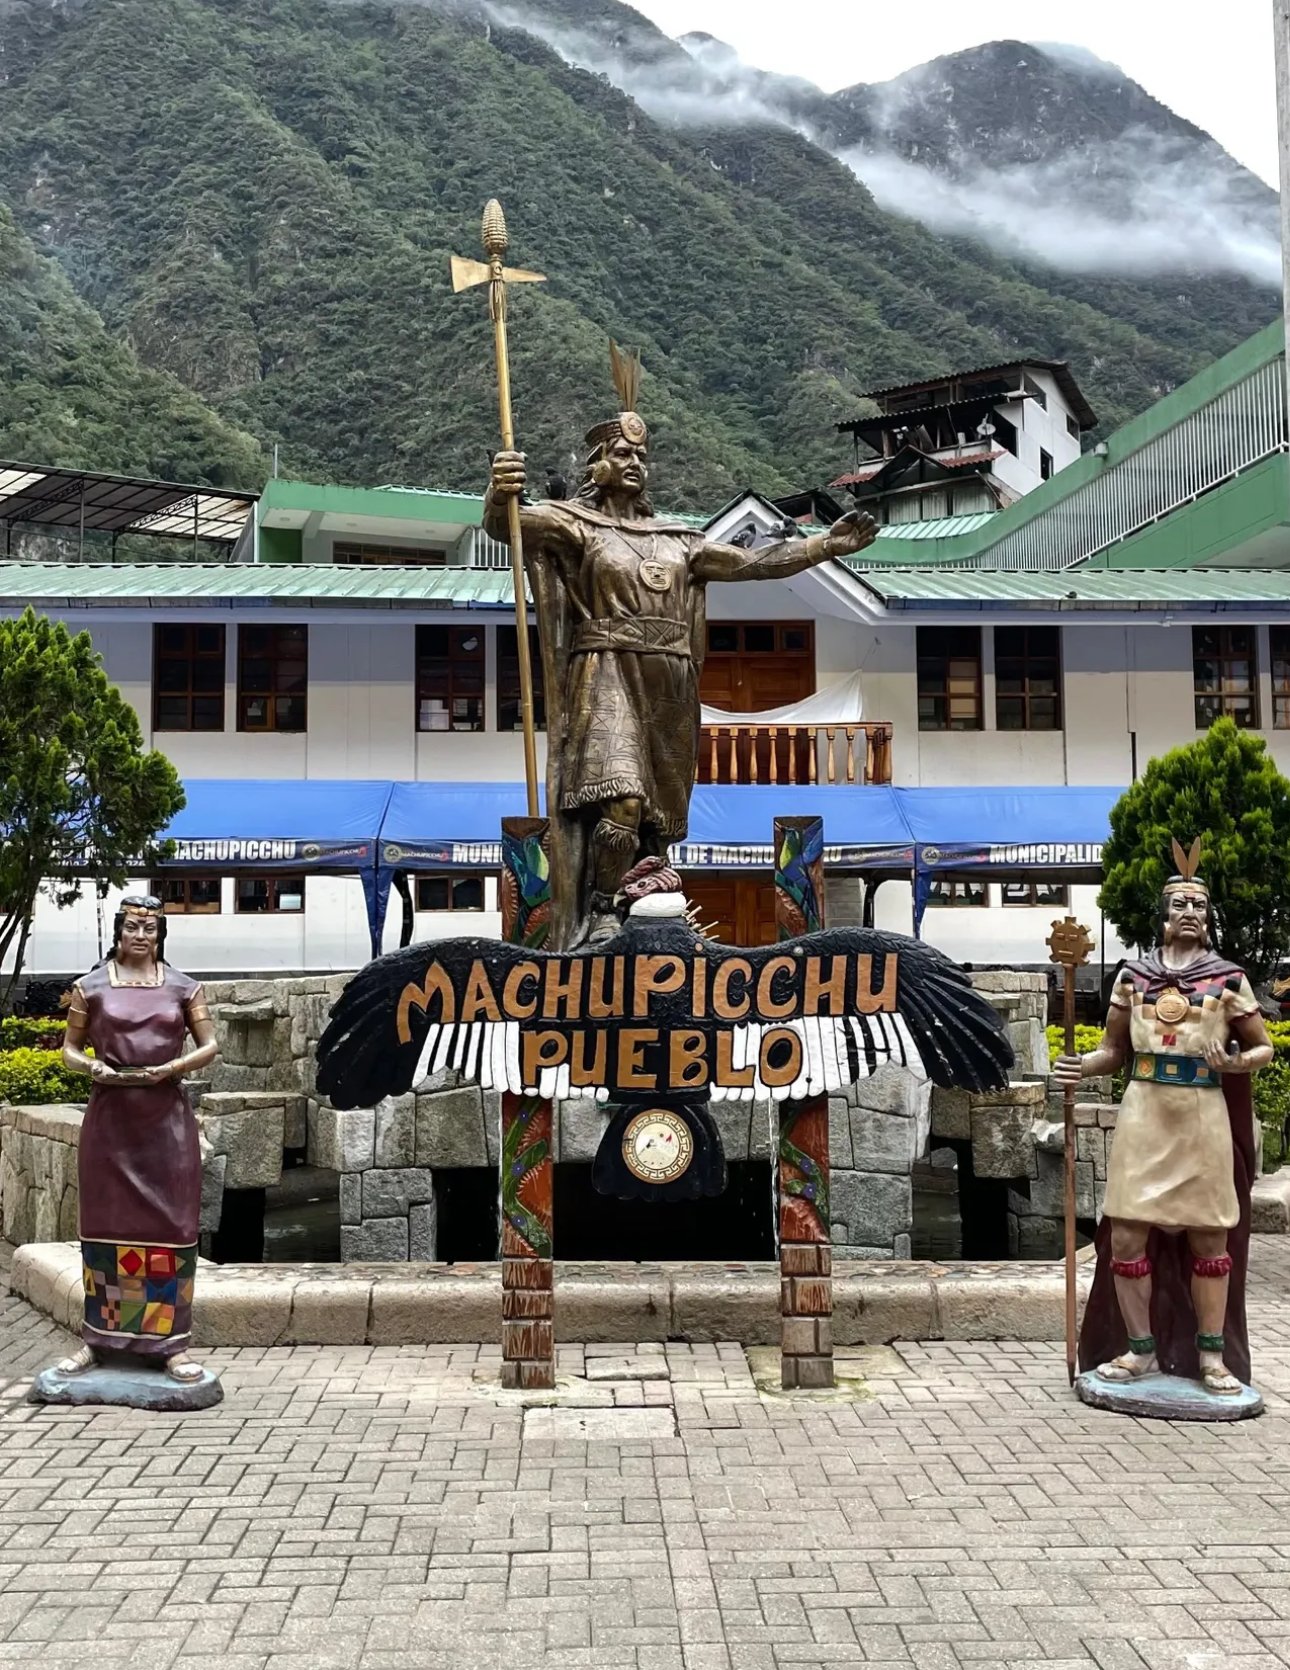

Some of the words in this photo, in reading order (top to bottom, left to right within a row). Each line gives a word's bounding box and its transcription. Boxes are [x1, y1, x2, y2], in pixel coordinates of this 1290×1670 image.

[452, 844, 502, 863] MUNI
[687, 845, 708, 864] DE
[990, 844, 1104, 863] MUNICIPALID
[396, 950, 900, 1045] MACHUPICCHU
[521, 1027, 802, 1089] PUEBLO
